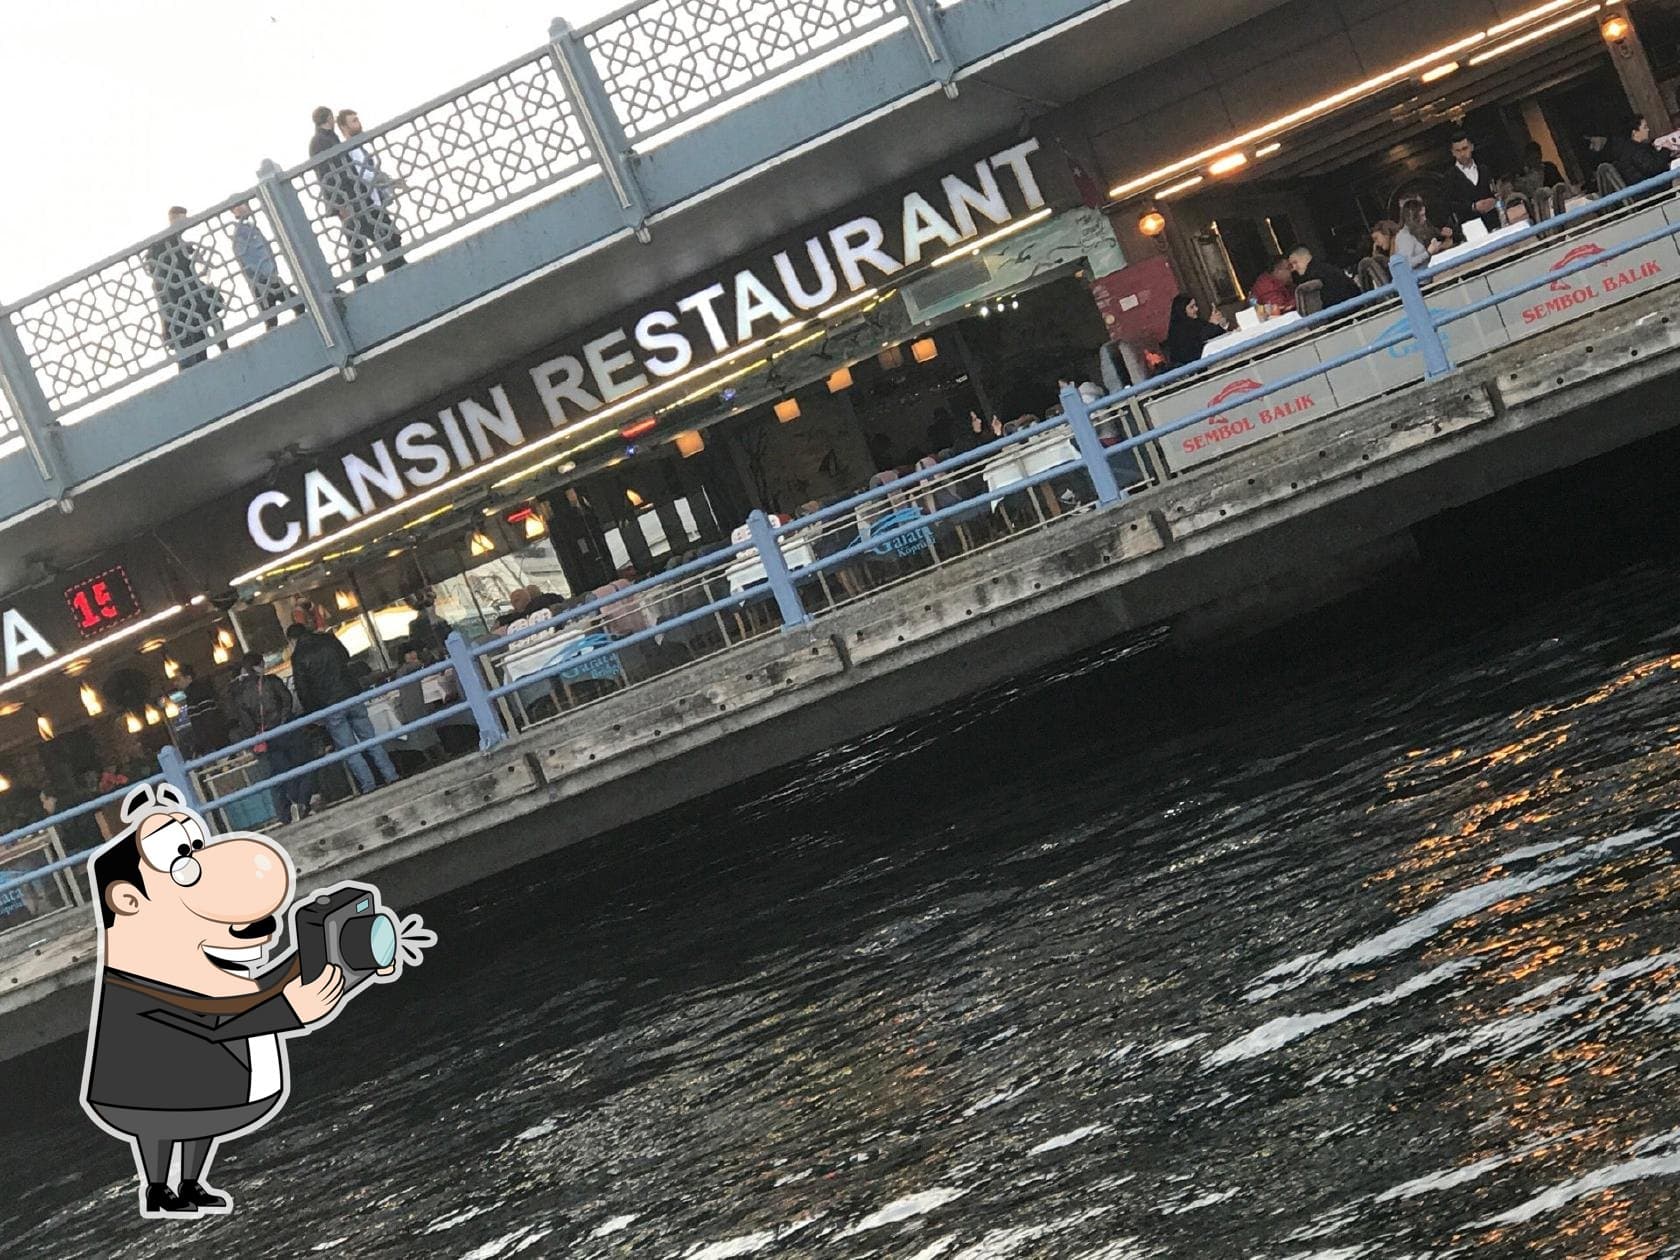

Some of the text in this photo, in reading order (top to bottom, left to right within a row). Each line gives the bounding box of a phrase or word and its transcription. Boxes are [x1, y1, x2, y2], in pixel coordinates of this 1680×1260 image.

[1521, 259, 1662, 325] SEMBOL BALIK
[247, 136, 1046, 553] CANSIN RESTAURANT
[1182, 393, 1316, 454] SEMBOL BALIK
[73, 580, 118, 629] 15
[2, 607, 57, 678] A
